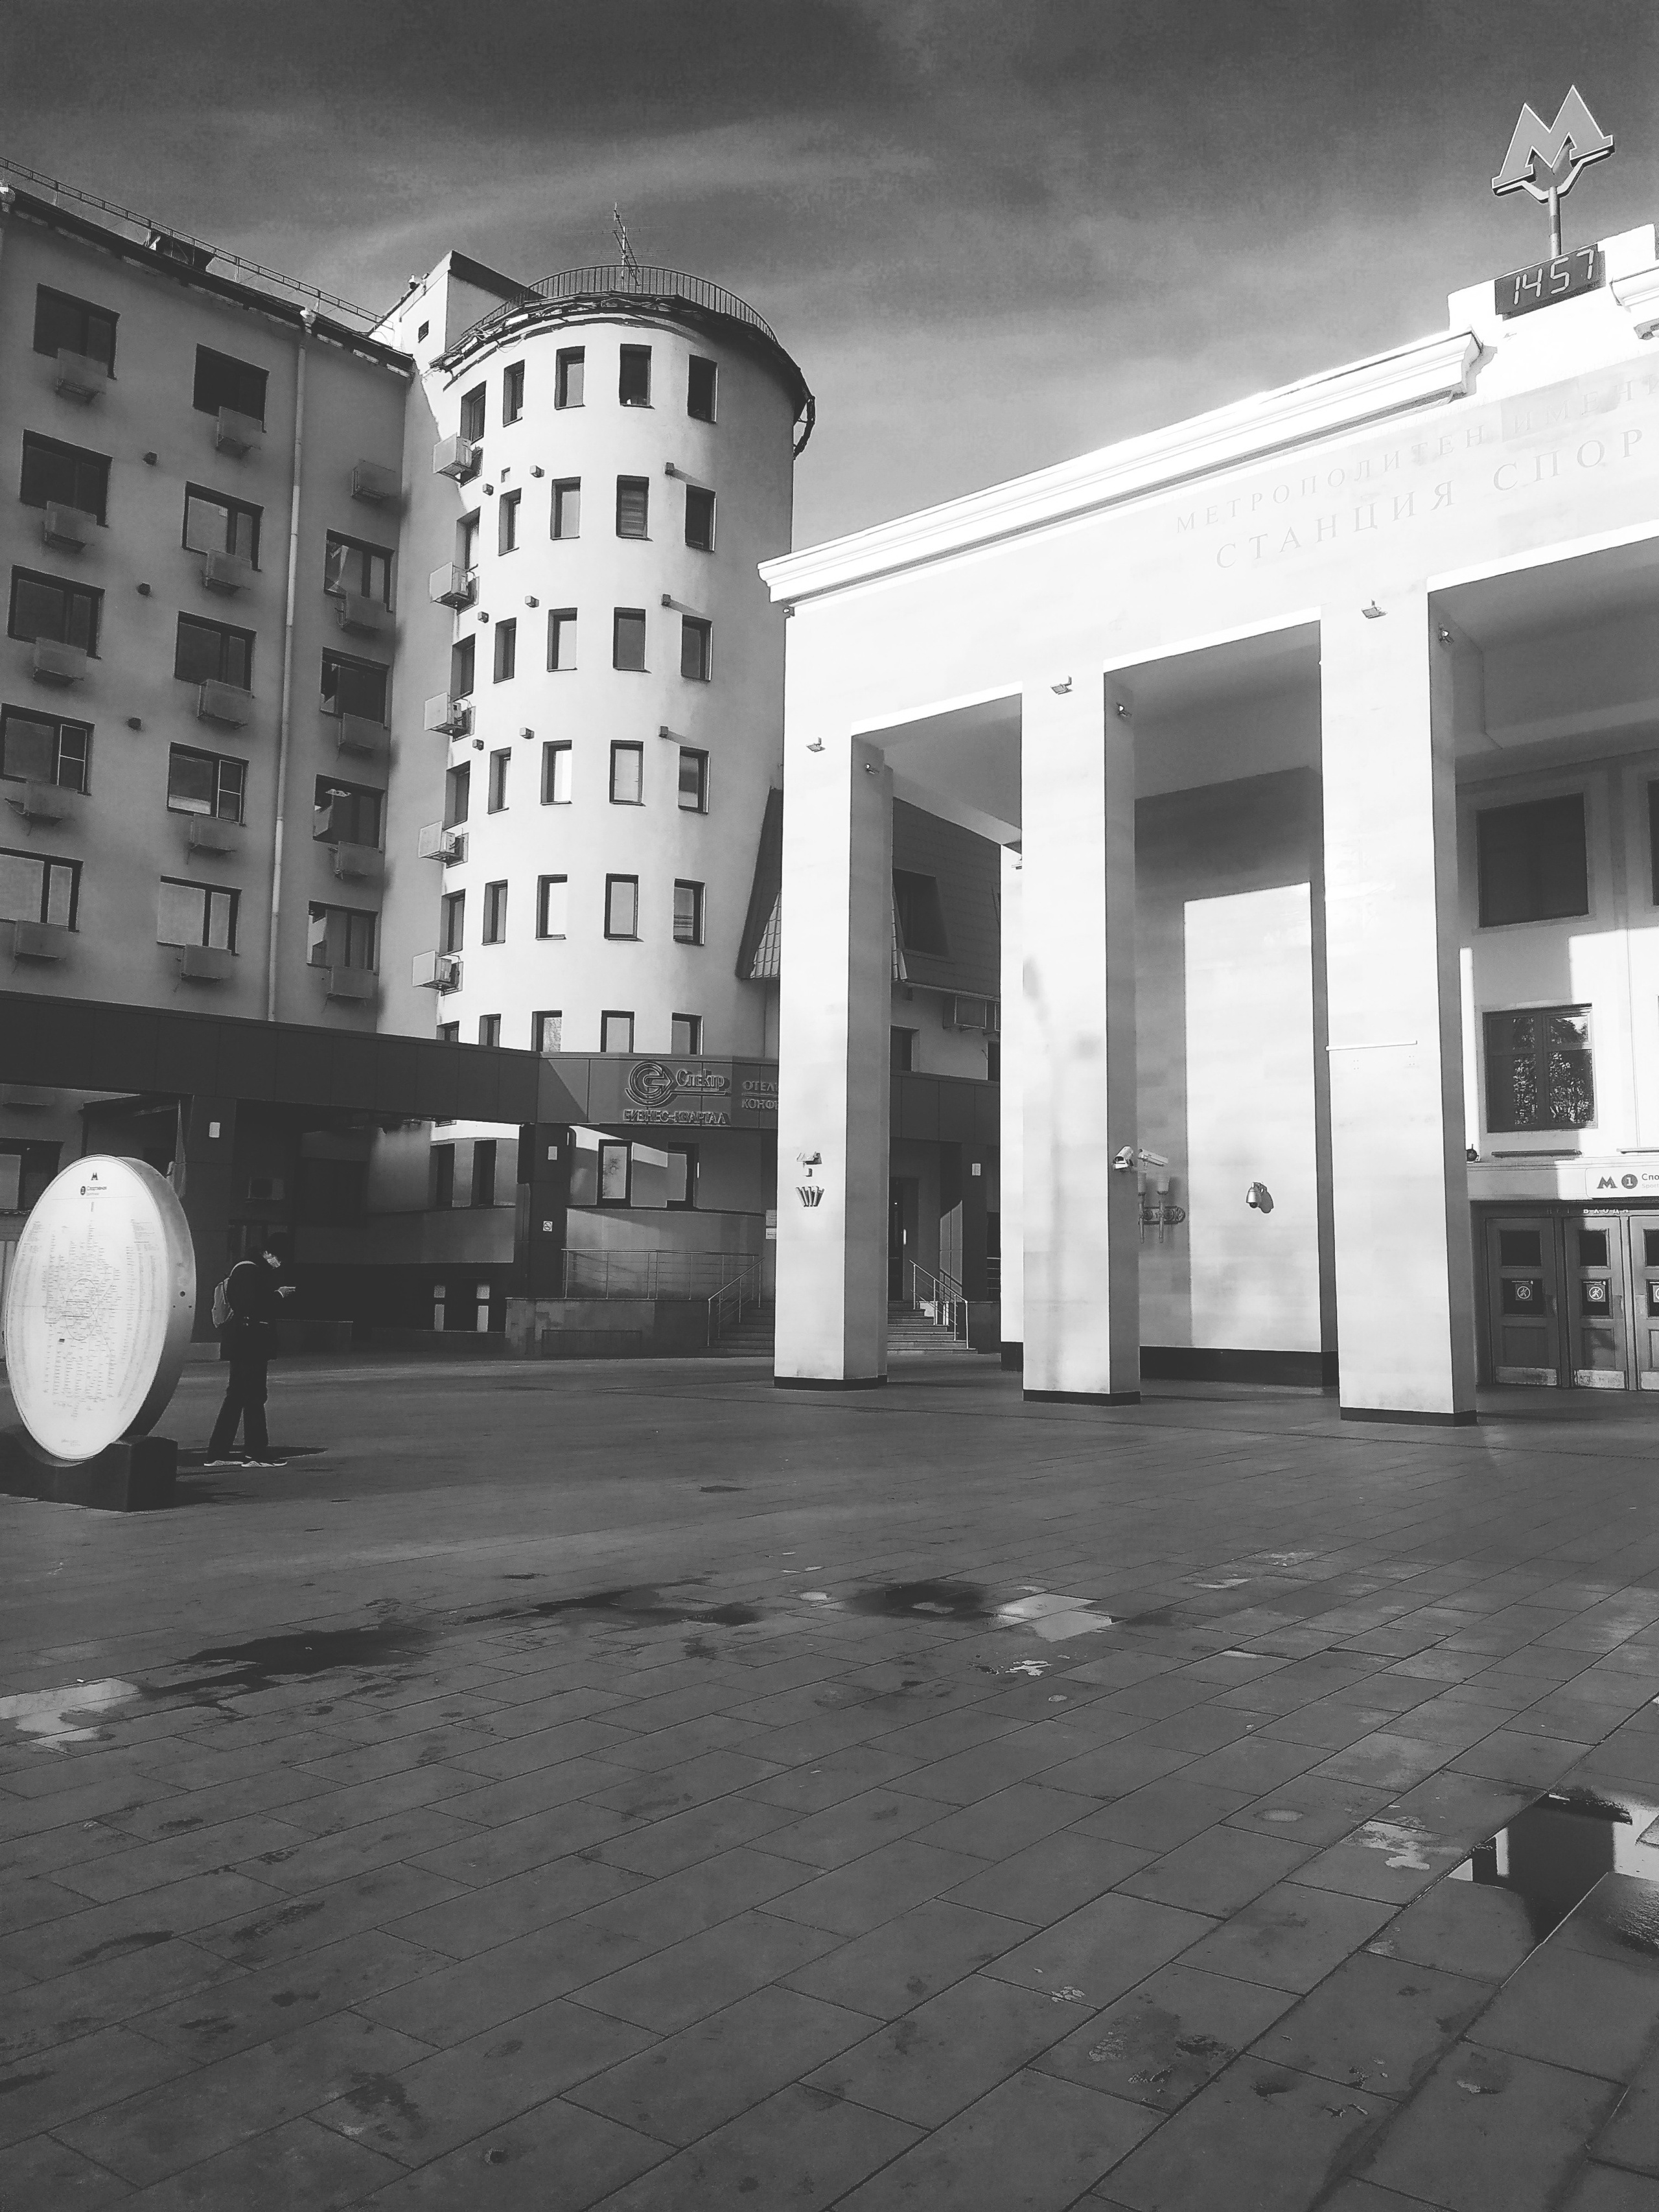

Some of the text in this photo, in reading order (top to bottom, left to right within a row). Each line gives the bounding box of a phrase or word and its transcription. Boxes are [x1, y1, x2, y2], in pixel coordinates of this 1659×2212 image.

[1513, 248, 1594, 305] 1457
[1176, 424, 1485, 534] МЕТРОПОЛИТЕН
[1216, 428, 1643, 569] СТАНЦИЯ СПОР
[676, 1069, 725, 1091] Спектр
[623, 1109, 726, 1124] БИЗНЕС-КВАРТАЛ
